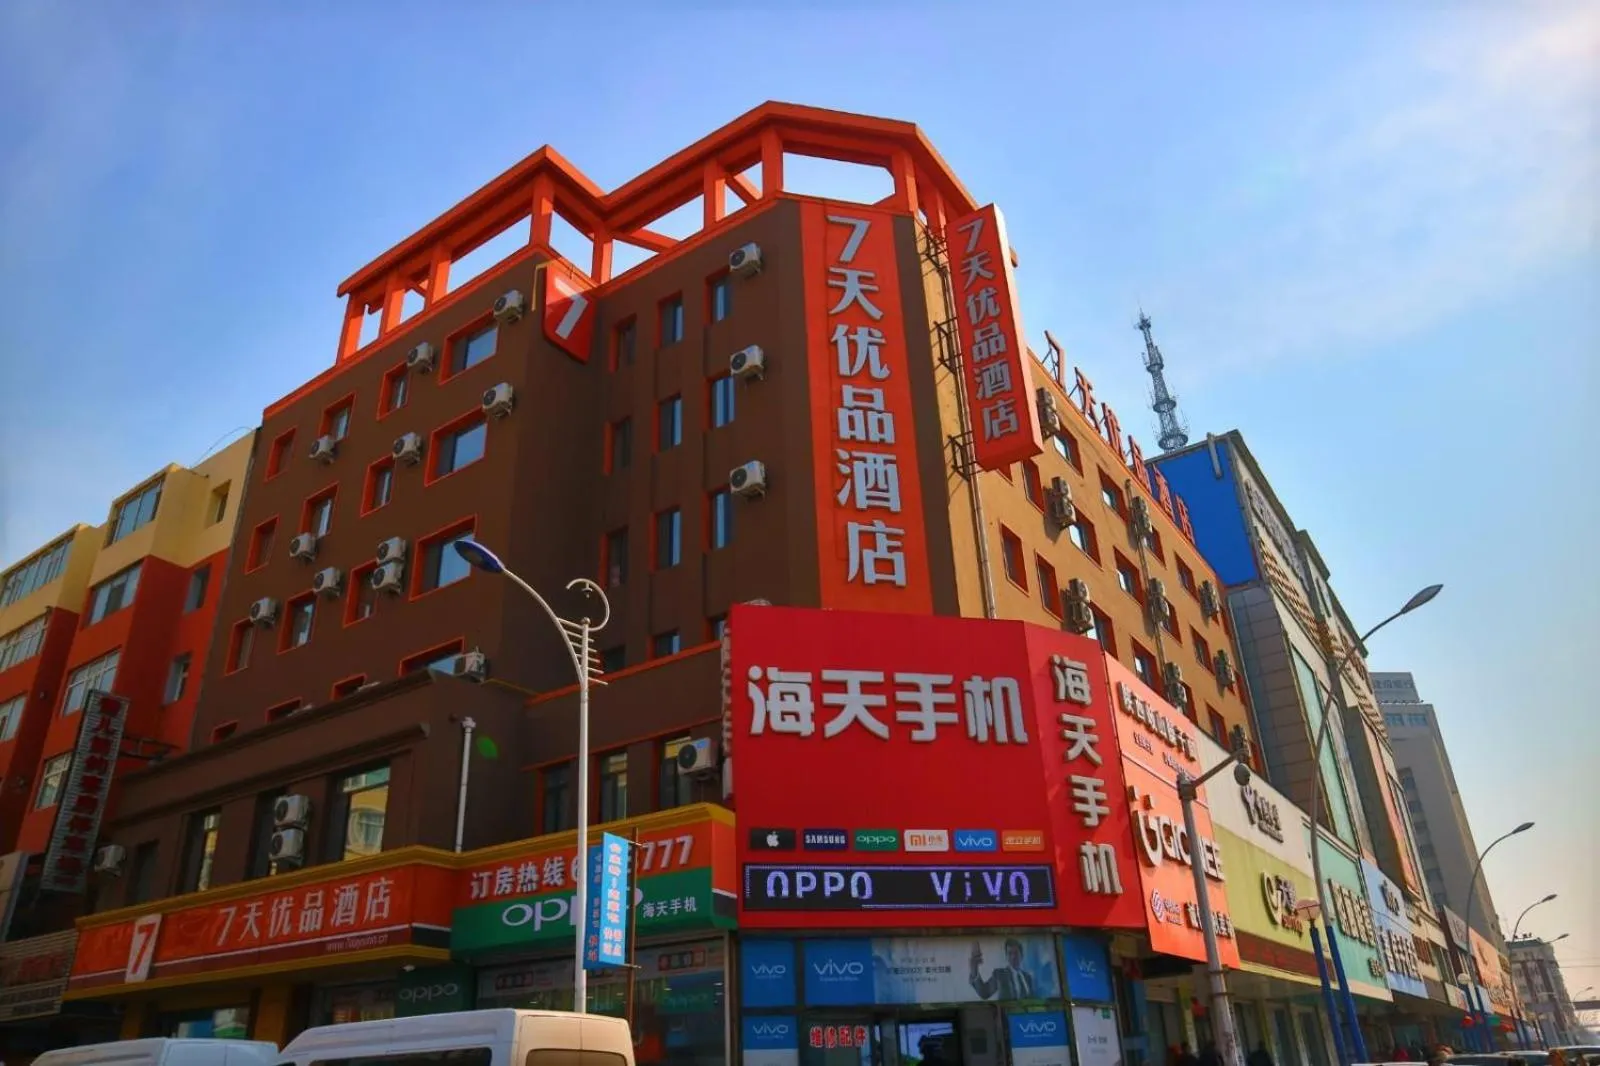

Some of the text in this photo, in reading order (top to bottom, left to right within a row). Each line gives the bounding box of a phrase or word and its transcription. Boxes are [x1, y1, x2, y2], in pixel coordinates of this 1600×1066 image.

[553, 275, 589, 340] 7
[958, 218, 1019, 441] 7天优品酒店
[826, 213, 908, 588] 7天优品酒店
[747, 665, 1029, 745] 海天手机
[1050, 654, 1123, 895] 海天手机
[805, 834, 846, 844] SAMSUNG
[217, 876, 394, 947] 7天优品酒店
[470, 856, 566, 900] 订房热线
[642, 896, 697, 918] 海天手机
[131, 922, 158, 975] 7
